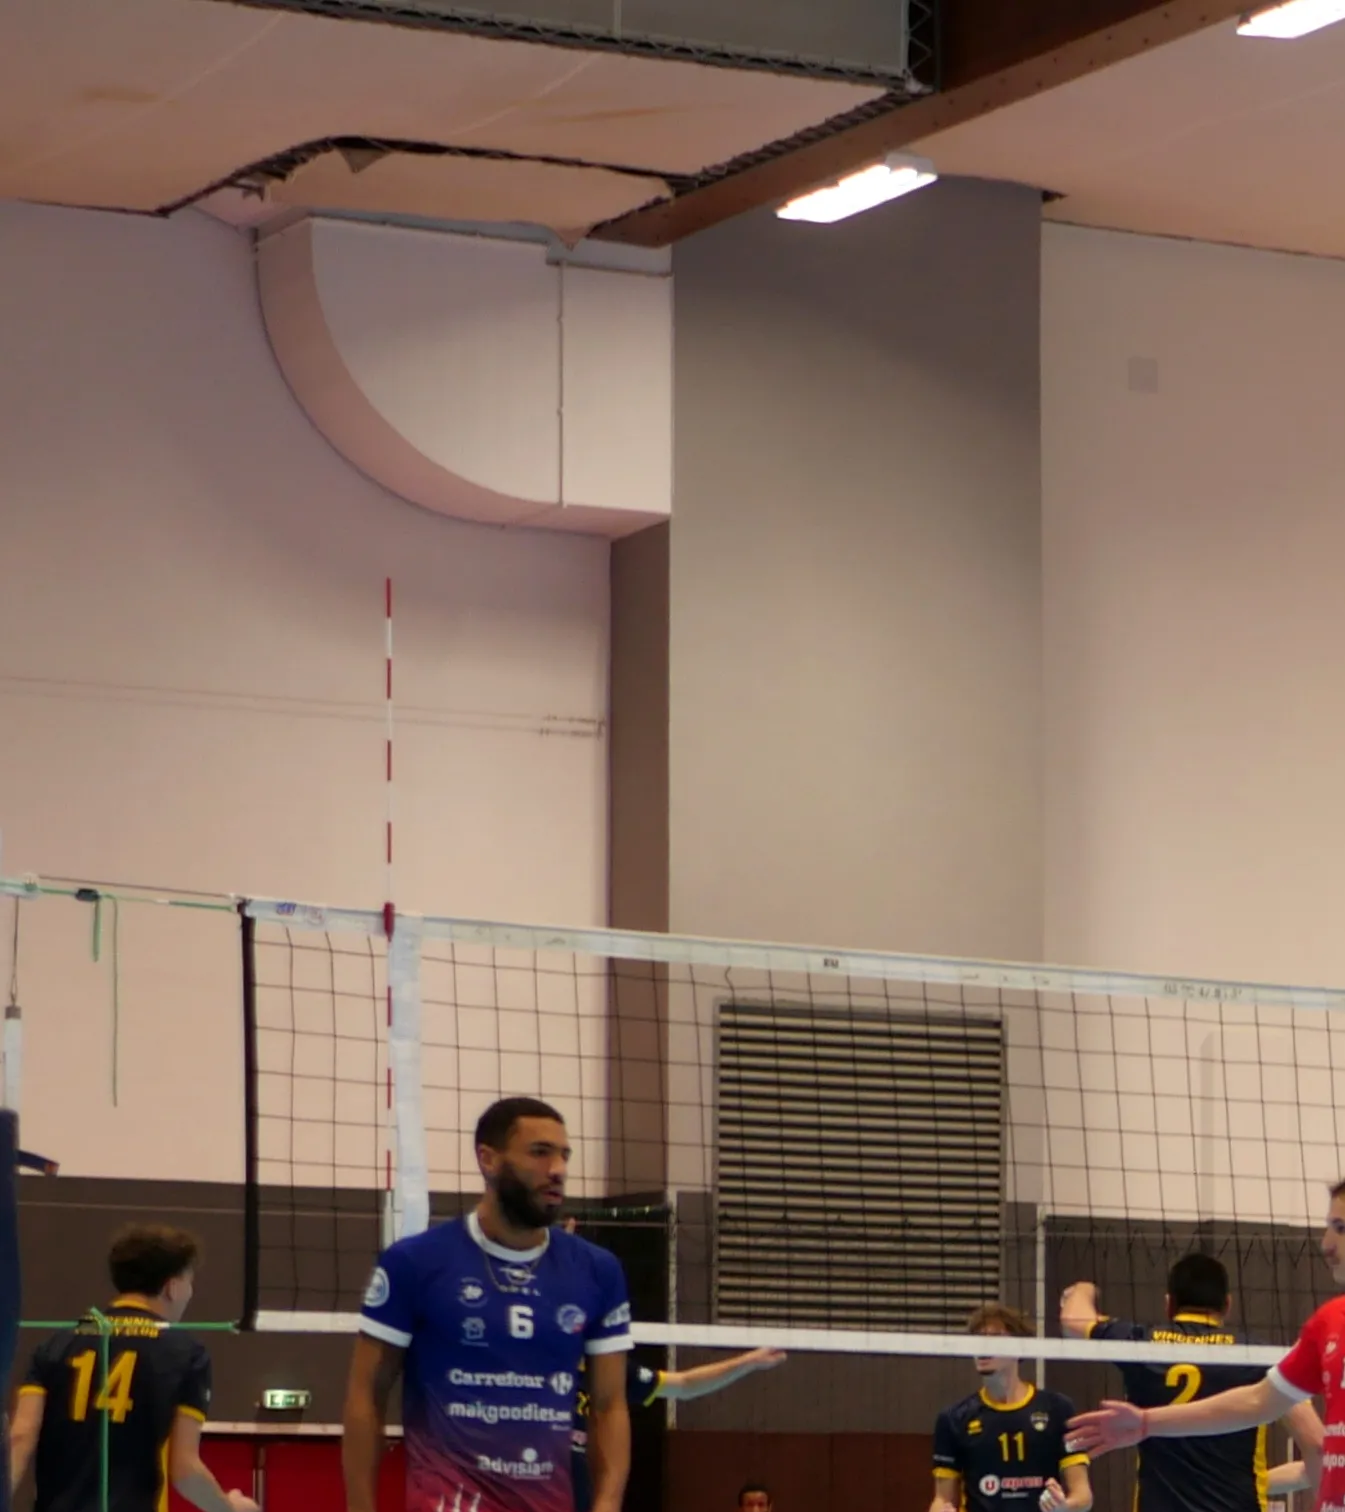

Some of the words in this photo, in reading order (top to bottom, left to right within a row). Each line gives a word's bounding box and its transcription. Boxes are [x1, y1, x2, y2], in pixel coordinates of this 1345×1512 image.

[509, 1304, 535, 1340] 6
[71, 1349, 138, 1424] 14
[448, 1367, 546, 1390] Carrefour
[998, 1430, 1025, 1462] 11
